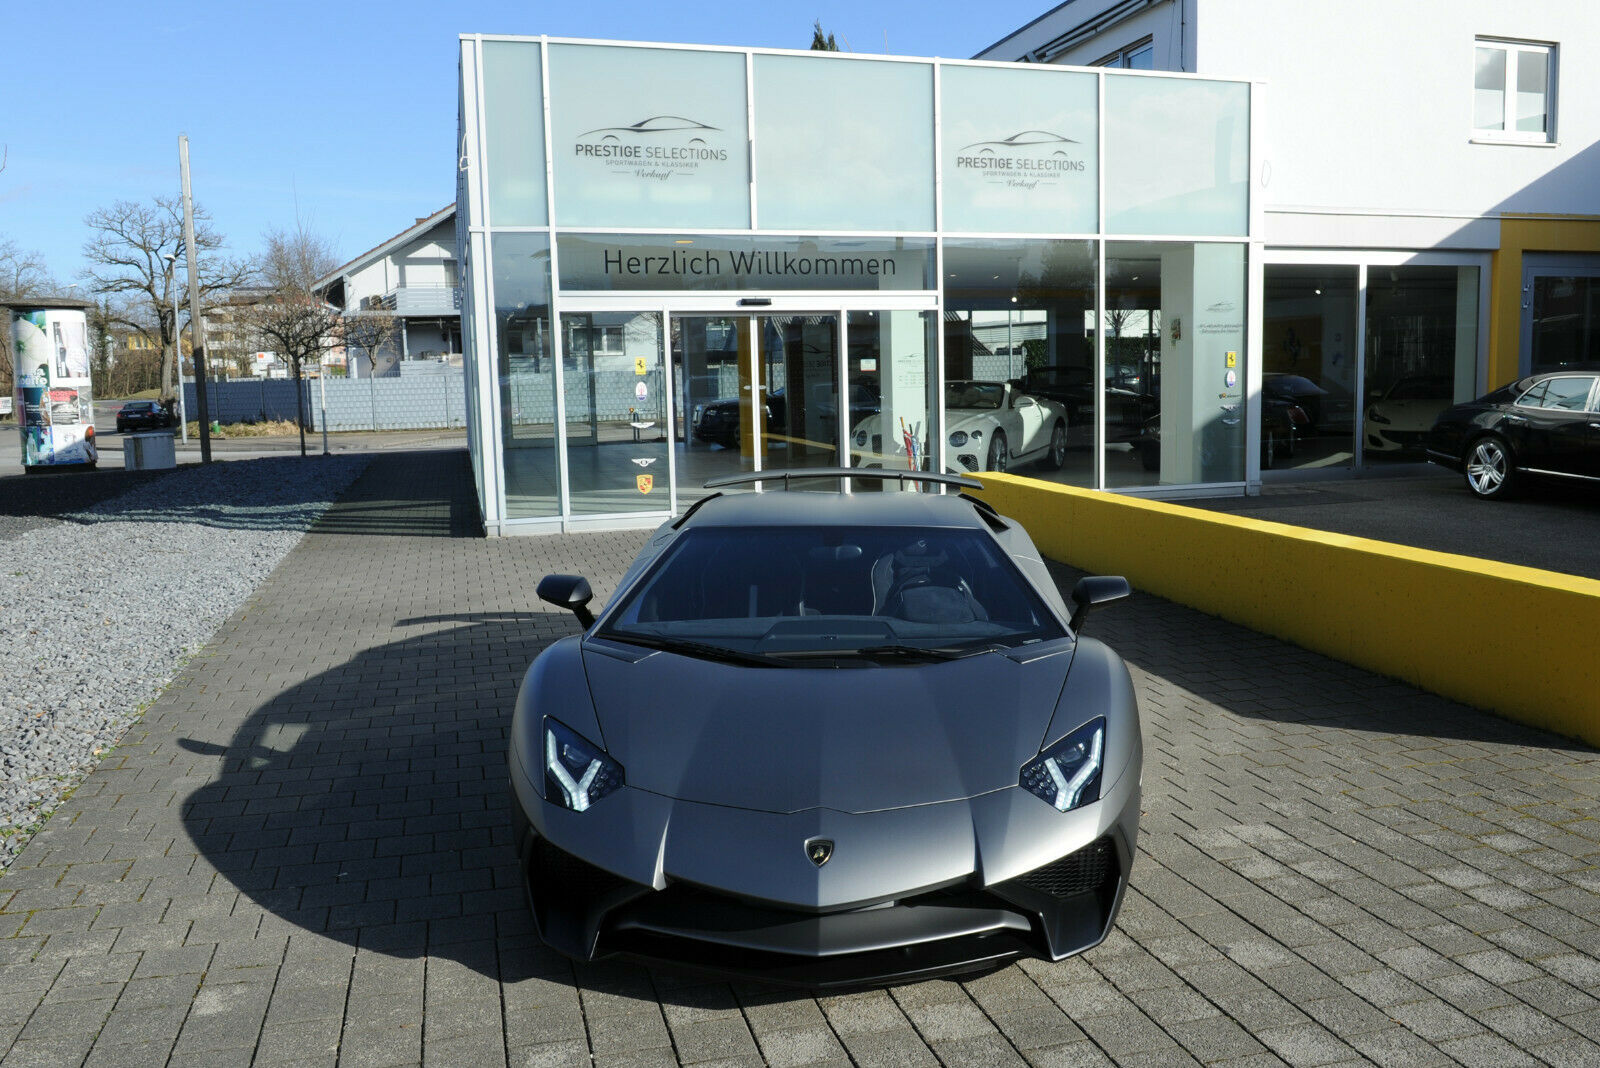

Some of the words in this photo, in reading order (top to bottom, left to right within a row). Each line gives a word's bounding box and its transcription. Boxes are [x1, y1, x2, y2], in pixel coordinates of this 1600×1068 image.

[575, 144, 642, 158] PRESTIGE
[645, 147, 728, 161] SELECTIONS
[605, 159, 652, 167] SPORTWAGEN
[661, 161, 699, 169] KLASSIKER
[957, 156, 1013, 169] PRESTIGE
[1016, 158, 1085, 171] SELECTIONS
[604, 249, 721, 275] Herzlich
[729, 250, 896, 275] Willkommen
